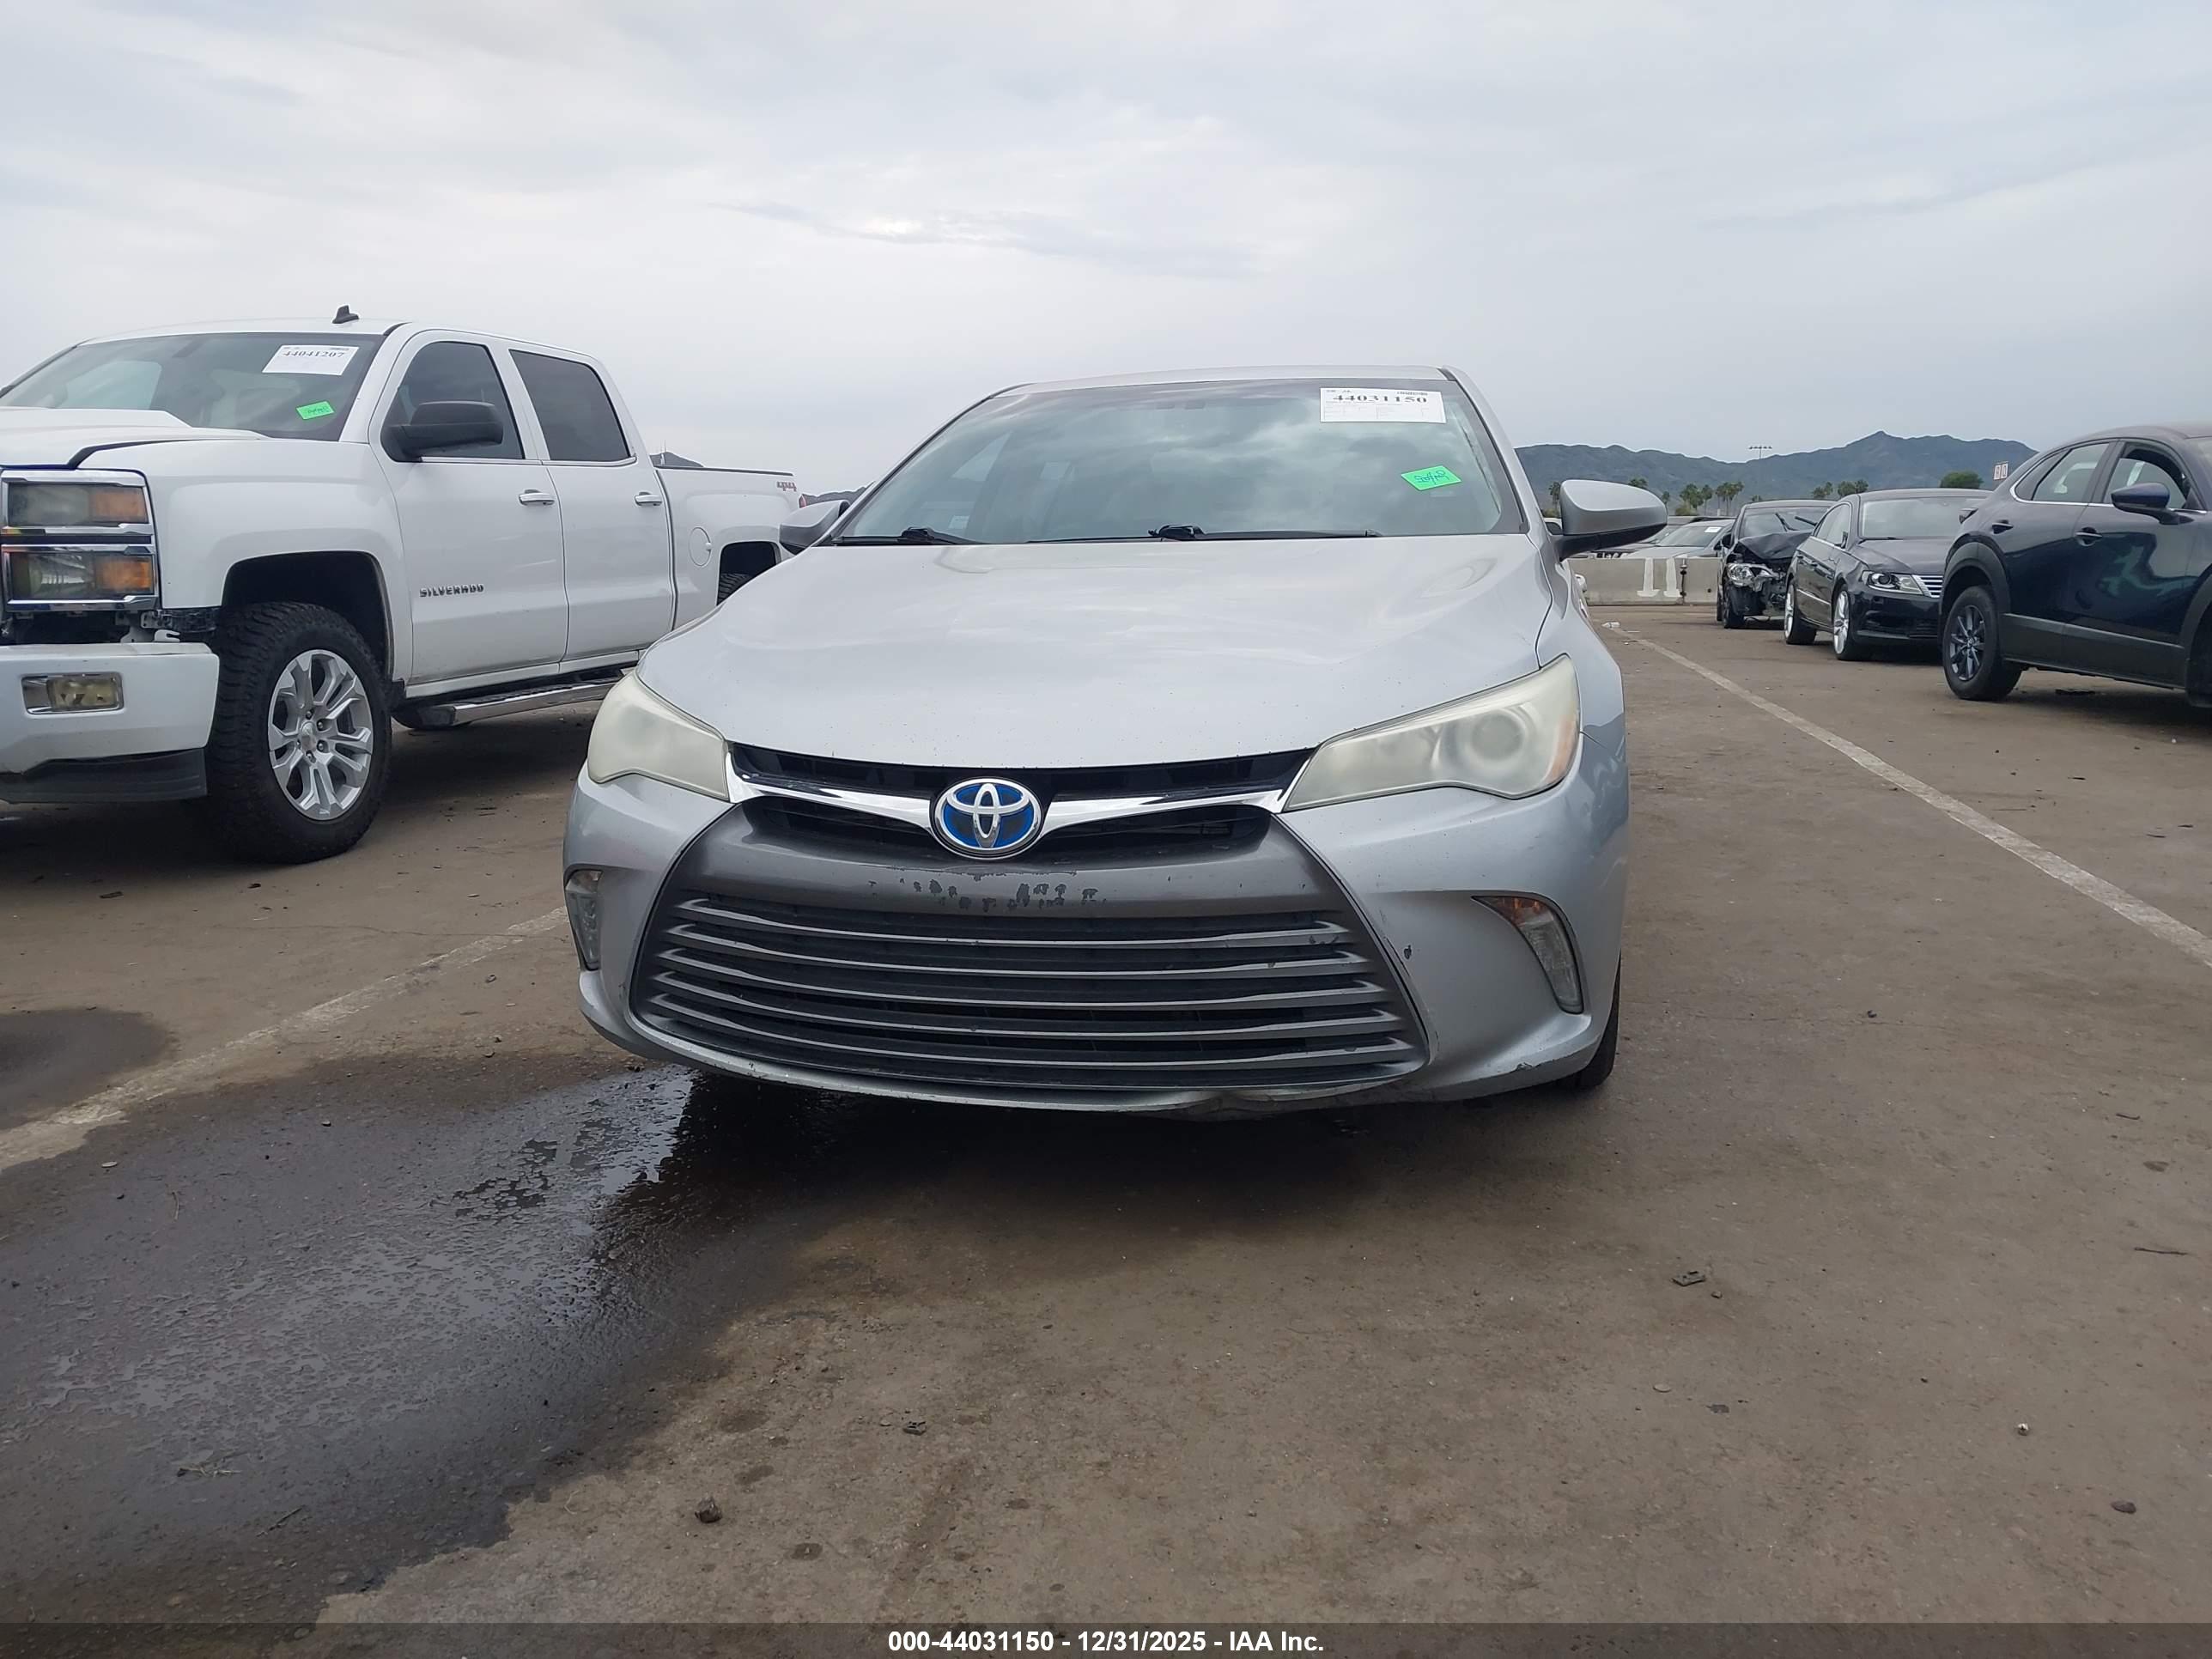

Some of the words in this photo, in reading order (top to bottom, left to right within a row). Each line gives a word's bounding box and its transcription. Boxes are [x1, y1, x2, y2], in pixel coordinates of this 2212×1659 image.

[283, 349, 345, 358] 44041207
[1333, 394, 1427, 404] 44031150
[419, 583, 484, 598] SILVERADO
